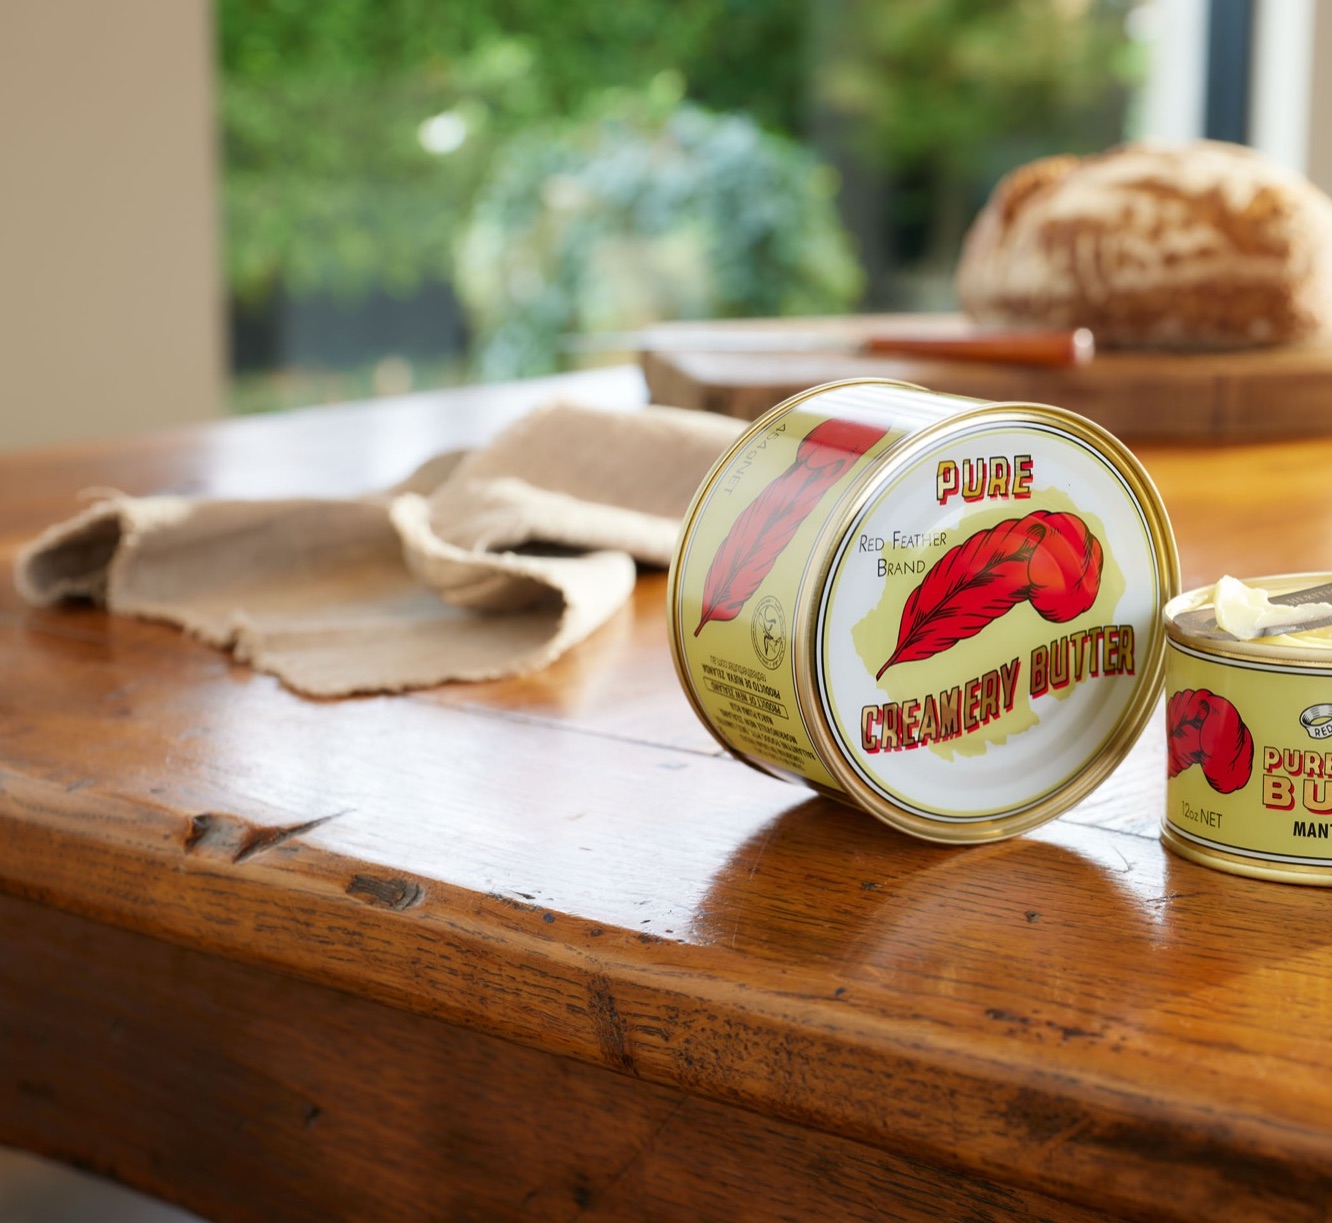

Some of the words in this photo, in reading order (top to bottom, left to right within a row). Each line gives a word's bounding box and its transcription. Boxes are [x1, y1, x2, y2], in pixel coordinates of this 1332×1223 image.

[936, 454, 1034, 505] PURE
[858, 533, 886, 553] RED
[892, 530, 948, 549] FEATHER
[877, 557, 926, 578] BRAND
[702, 664, 725, 680] ZELANDA
[726, 672, 744, 688] NUEVA
[711, 681, 733, 699] ZEALAND
[745, 678, 752, 690] DE
[753, 682, 781, 700] PRODUCTO
[860, 657, 1021, 755] CREAMERY
[1030, 625, 1136, 695] BUTTER
[735, 691, 747, 703] NEW
[749, 695, 756, 706] OF
[758, 699, 781, 715] PRODUCT
[1181, 800, 1199, 822] 12oz
[1200, 808, 1222, 828] NET
